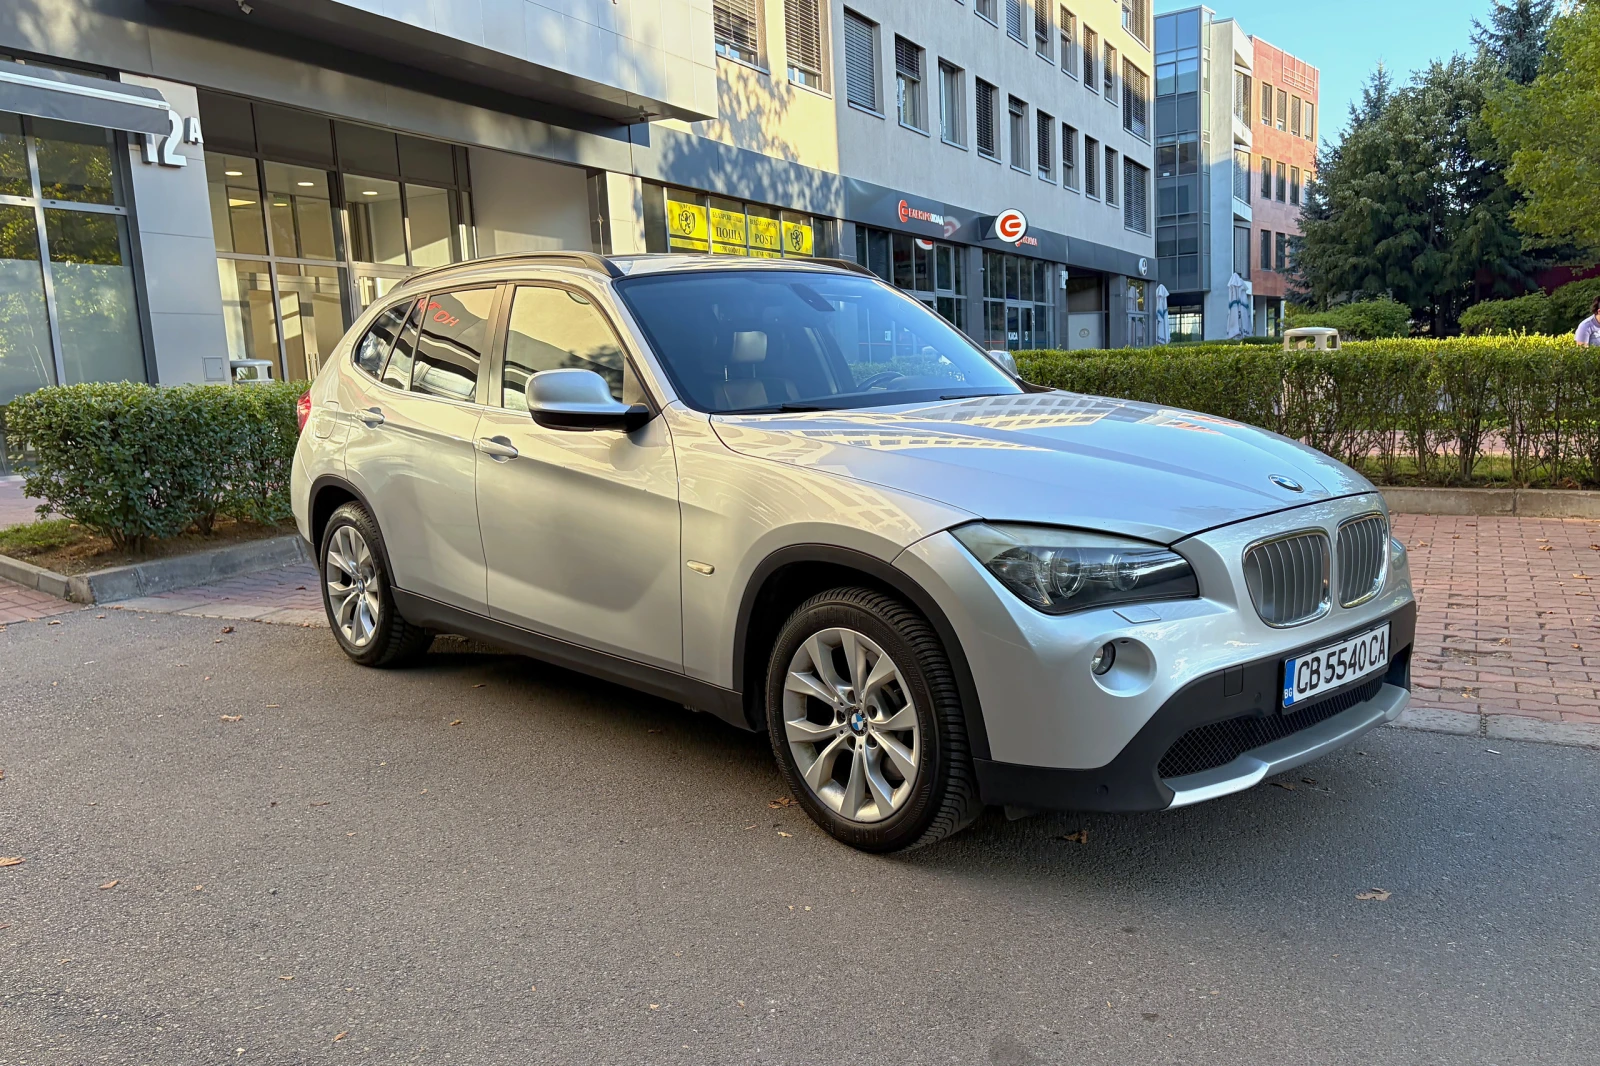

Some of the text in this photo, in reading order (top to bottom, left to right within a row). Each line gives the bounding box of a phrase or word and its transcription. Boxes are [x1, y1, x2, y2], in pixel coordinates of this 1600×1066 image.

[754, 233, 774, 246] POST
[1296, 630, 1386, 694] CB 5540 CA
[1284, 688, 1293, 699] BG
